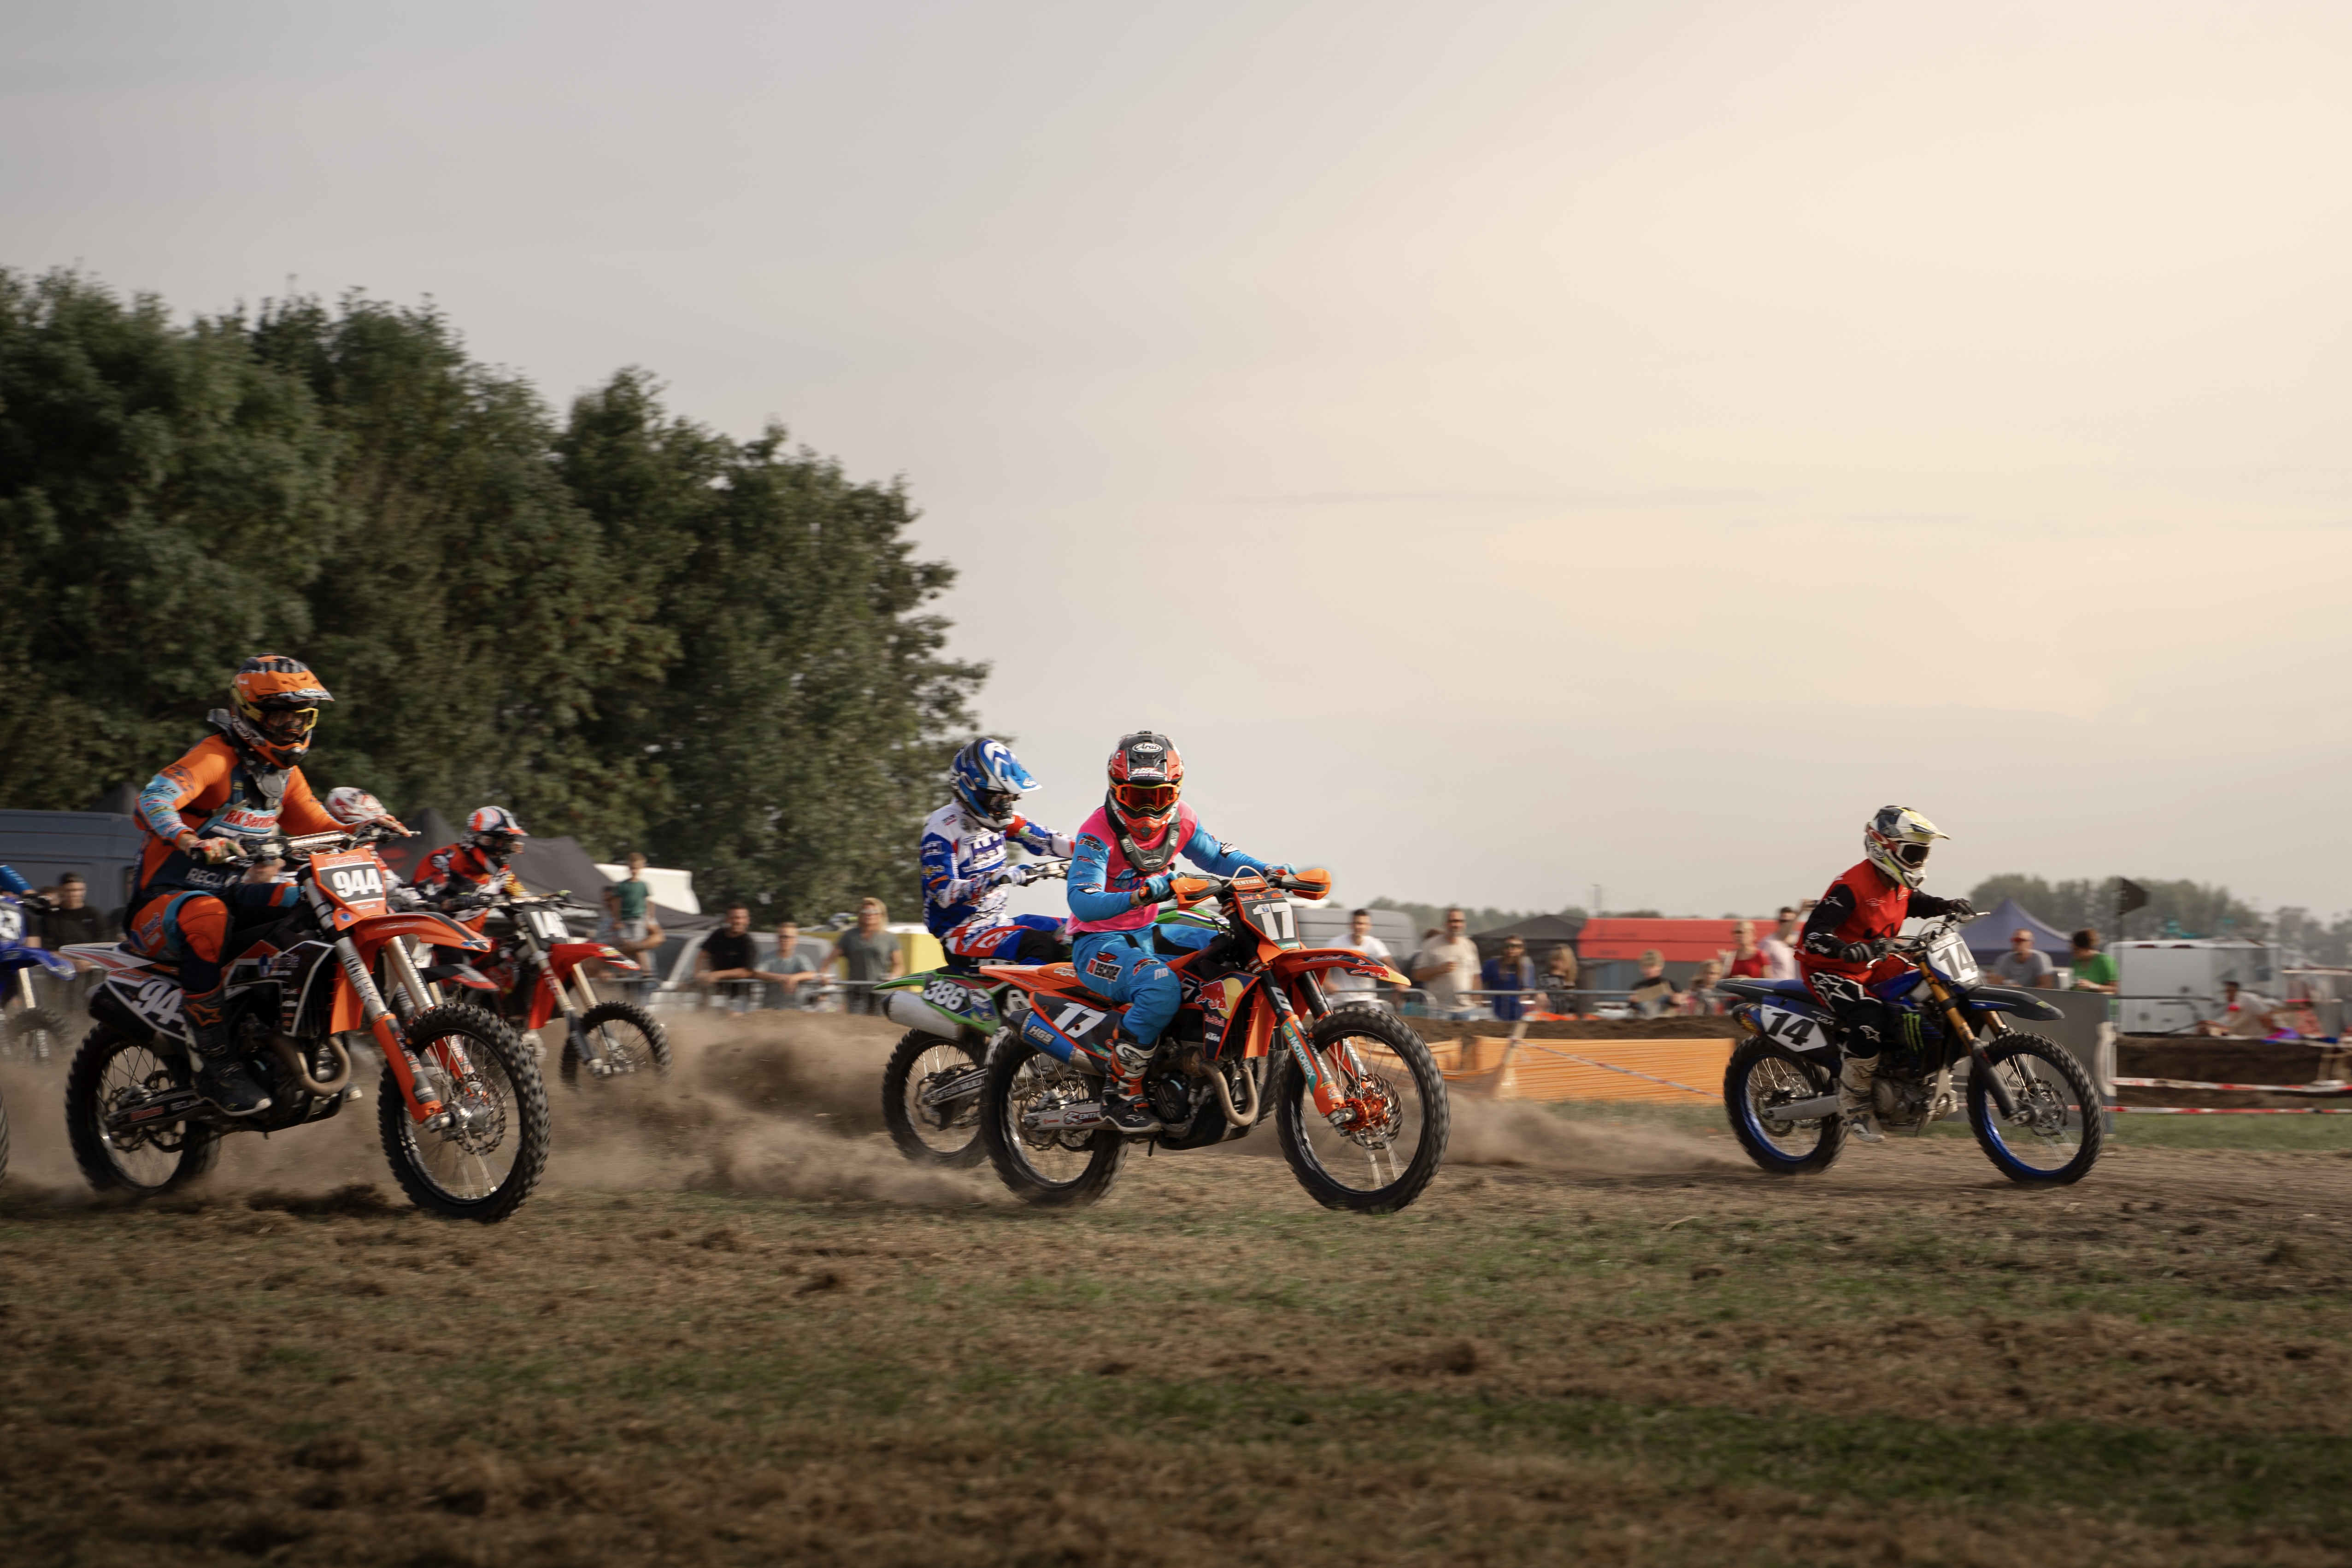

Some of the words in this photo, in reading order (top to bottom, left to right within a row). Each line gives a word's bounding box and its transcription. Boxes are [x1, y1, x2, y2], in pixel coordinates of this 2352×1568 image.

[331, 869, 383, 898] 944
[1252, 902, 1295, 940] 17
[1938, 943, 1977, 981] 14
[129, 981, 187, 1031] 94
[922, 980, 967, 1010] 386
[1028, 1025, 1055, 1043] HGS
[1053, 1002, 1108, 1038] 17
[1205, 1032, 1221, 1042] KTM
[1766, 1012, 1815, 1046] 14
[1290, 1036, 1317, 1079] MOTOREX
